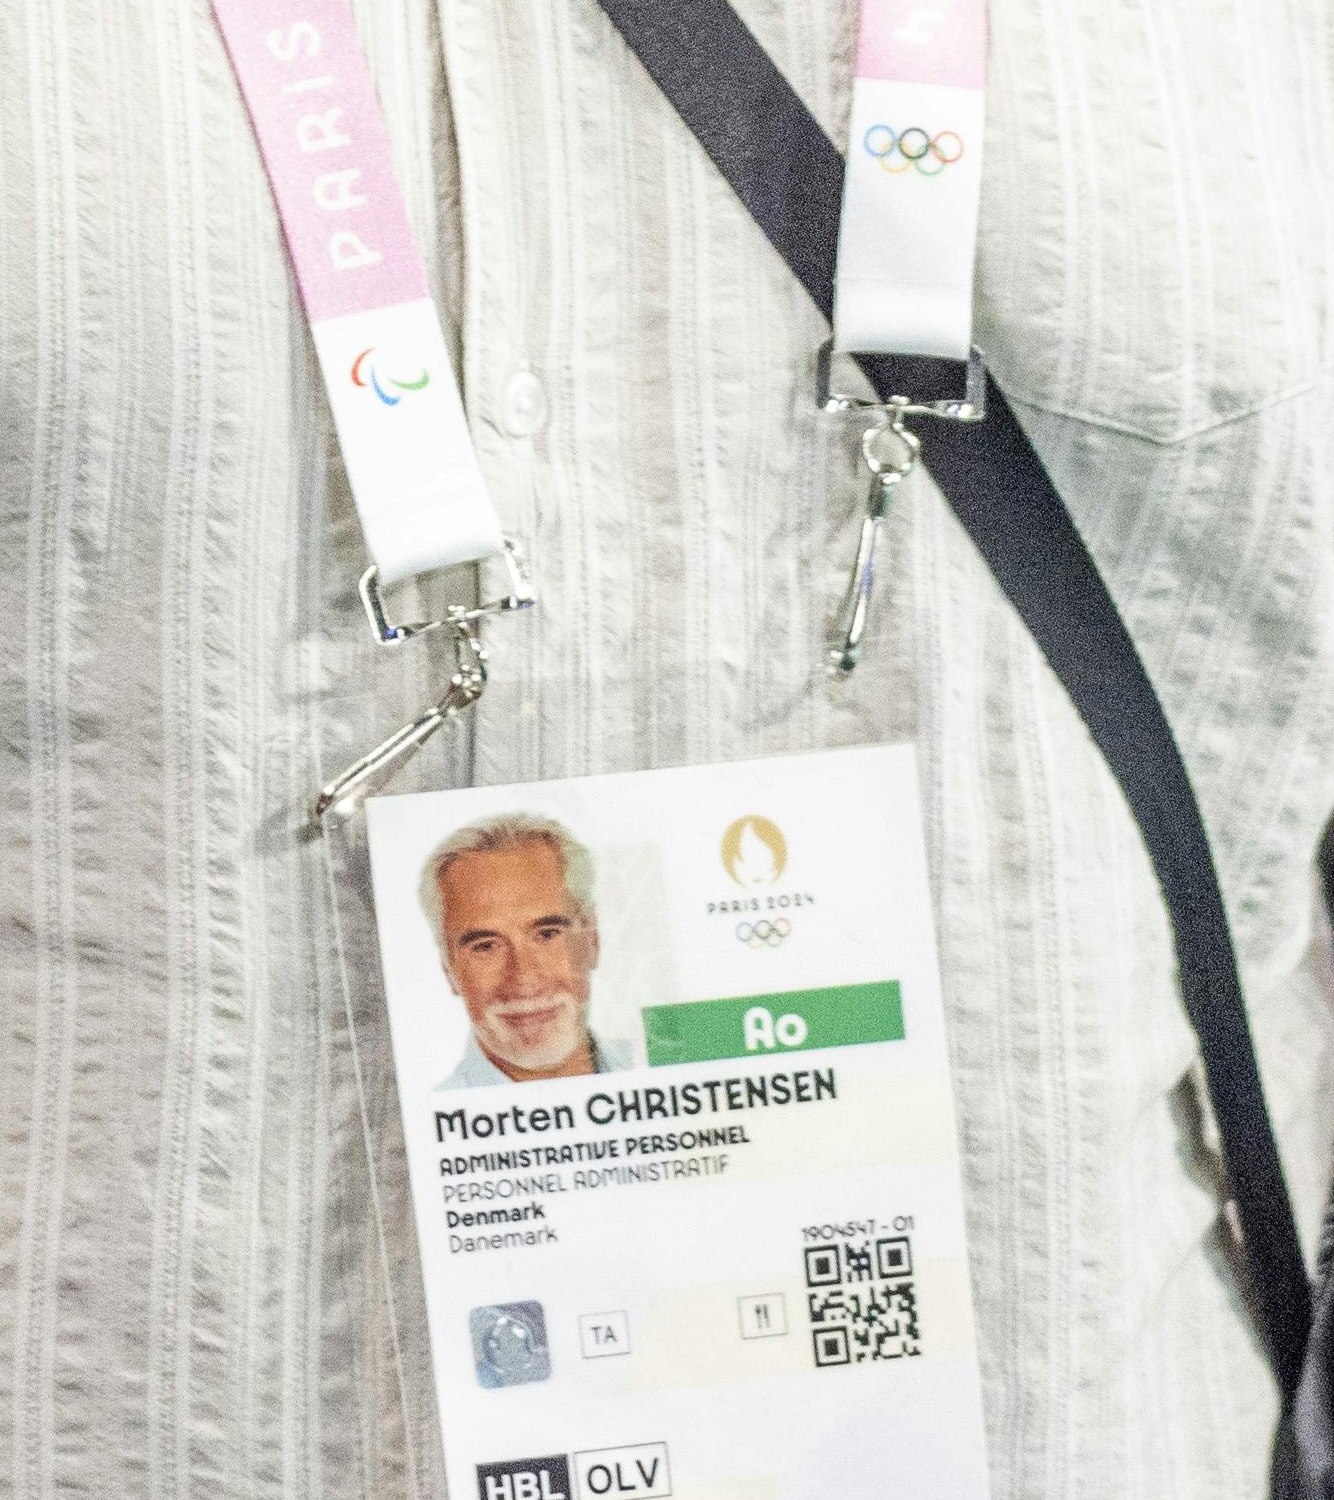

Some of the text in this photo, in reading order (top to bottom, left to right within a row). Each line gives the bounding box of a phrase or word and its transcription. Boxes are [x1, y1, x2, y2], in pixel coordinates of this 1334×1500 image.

[259, 18, 385, 270] PARIS
[707, 893, 815, 915] PARIS 2024
[744, 1006, 808, 1050] Ao
[434, 1067, 838, 1143] Morten CHRISTENSEN
[439, 1125, 751, 1177] ADMINISTRATIVE PERSONNEL
[443, 1154, 731, 1204] PERSONNEL ADMINISTRATIF
[445, 1201, 546, 1229] Denmark
[449, 1225, 560, 1255] Danemark
[590, 1324, 618, 1345] TA
[587, 1457, 659, 1494] OLV
